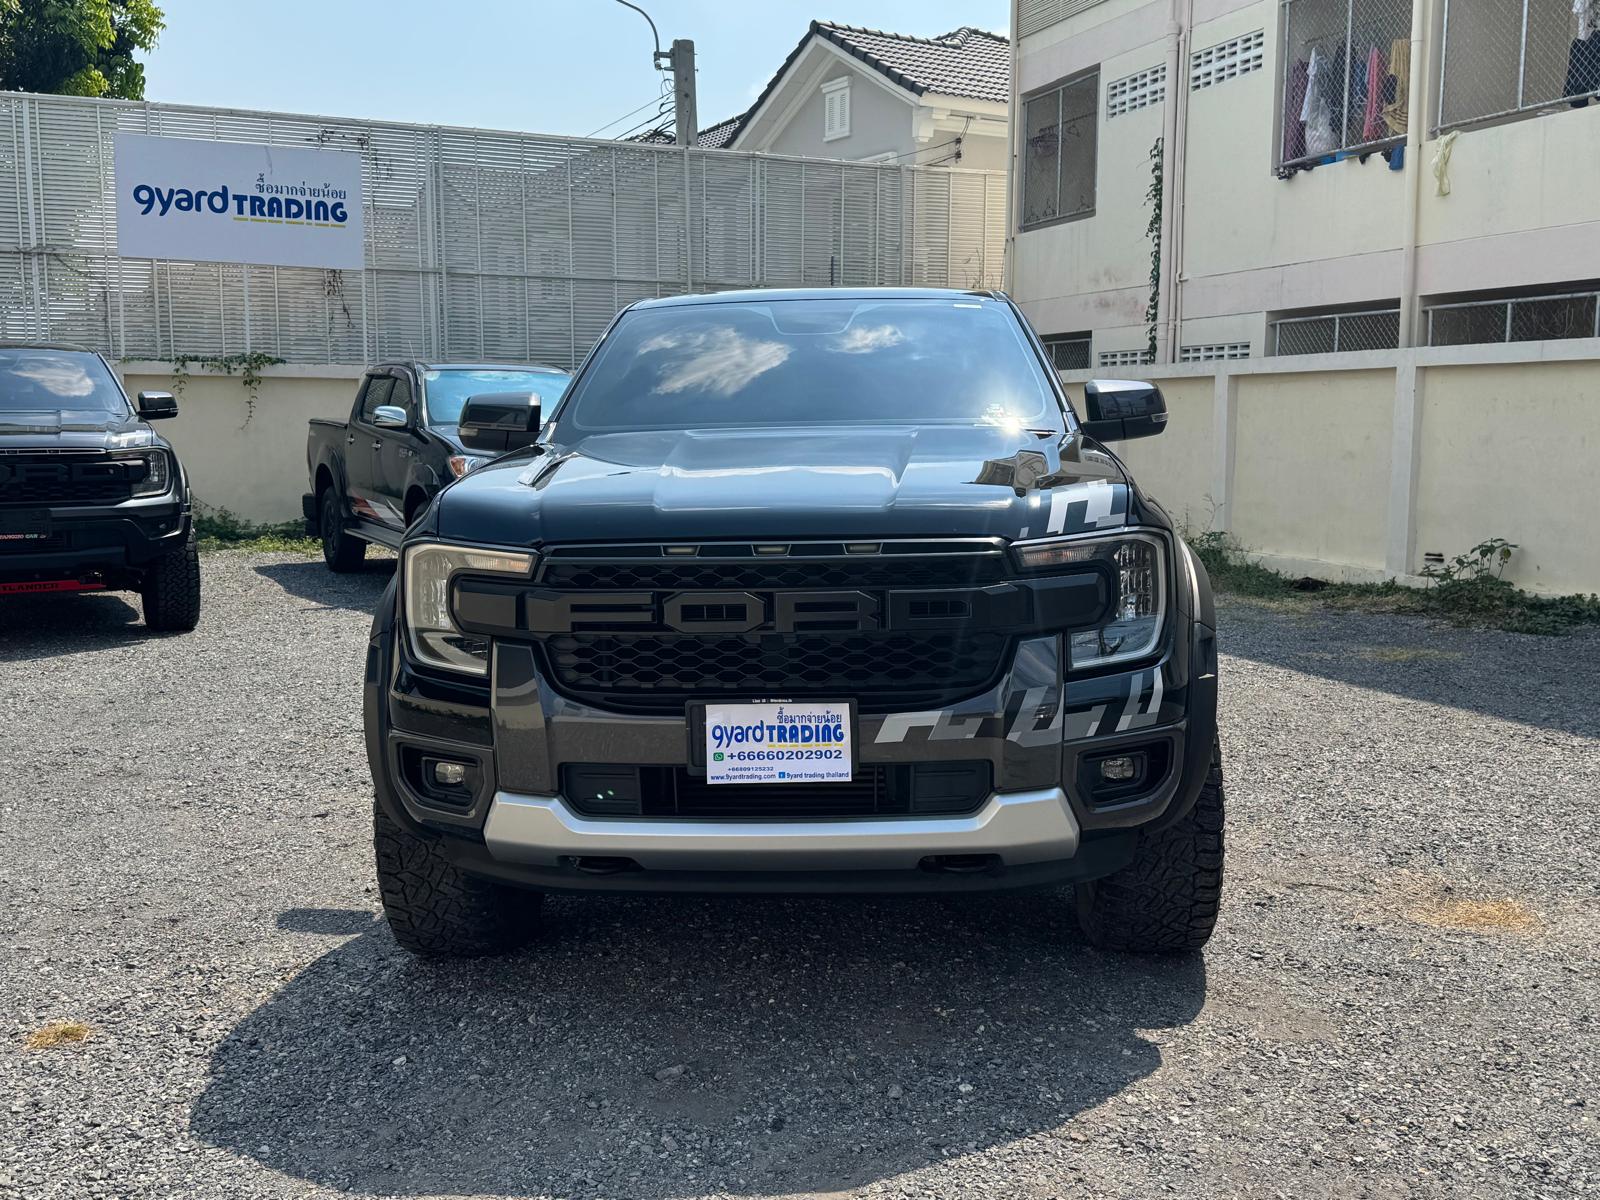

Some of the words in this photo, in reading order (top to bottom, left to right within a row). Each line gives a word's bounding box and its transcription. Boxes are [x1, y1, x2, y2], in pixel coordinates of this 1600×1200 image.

[255, 173, 347, 200] ซื้อมากจ่ายน้อย
[133, 184, 228, 216] 9yard
[232, 194, 348, 223] TRADING
[528, 590, 992, 635] FORD
[776, 706, 842, 724] ซื้อมากจ่ายน้อย
[711, 720, 764, 749] 9yard
[766, 723, 845, 744] TRADING
[727, 749, 843, 761] +66660202902
[710, 773, 776, 781] www.9yardtrading.com
